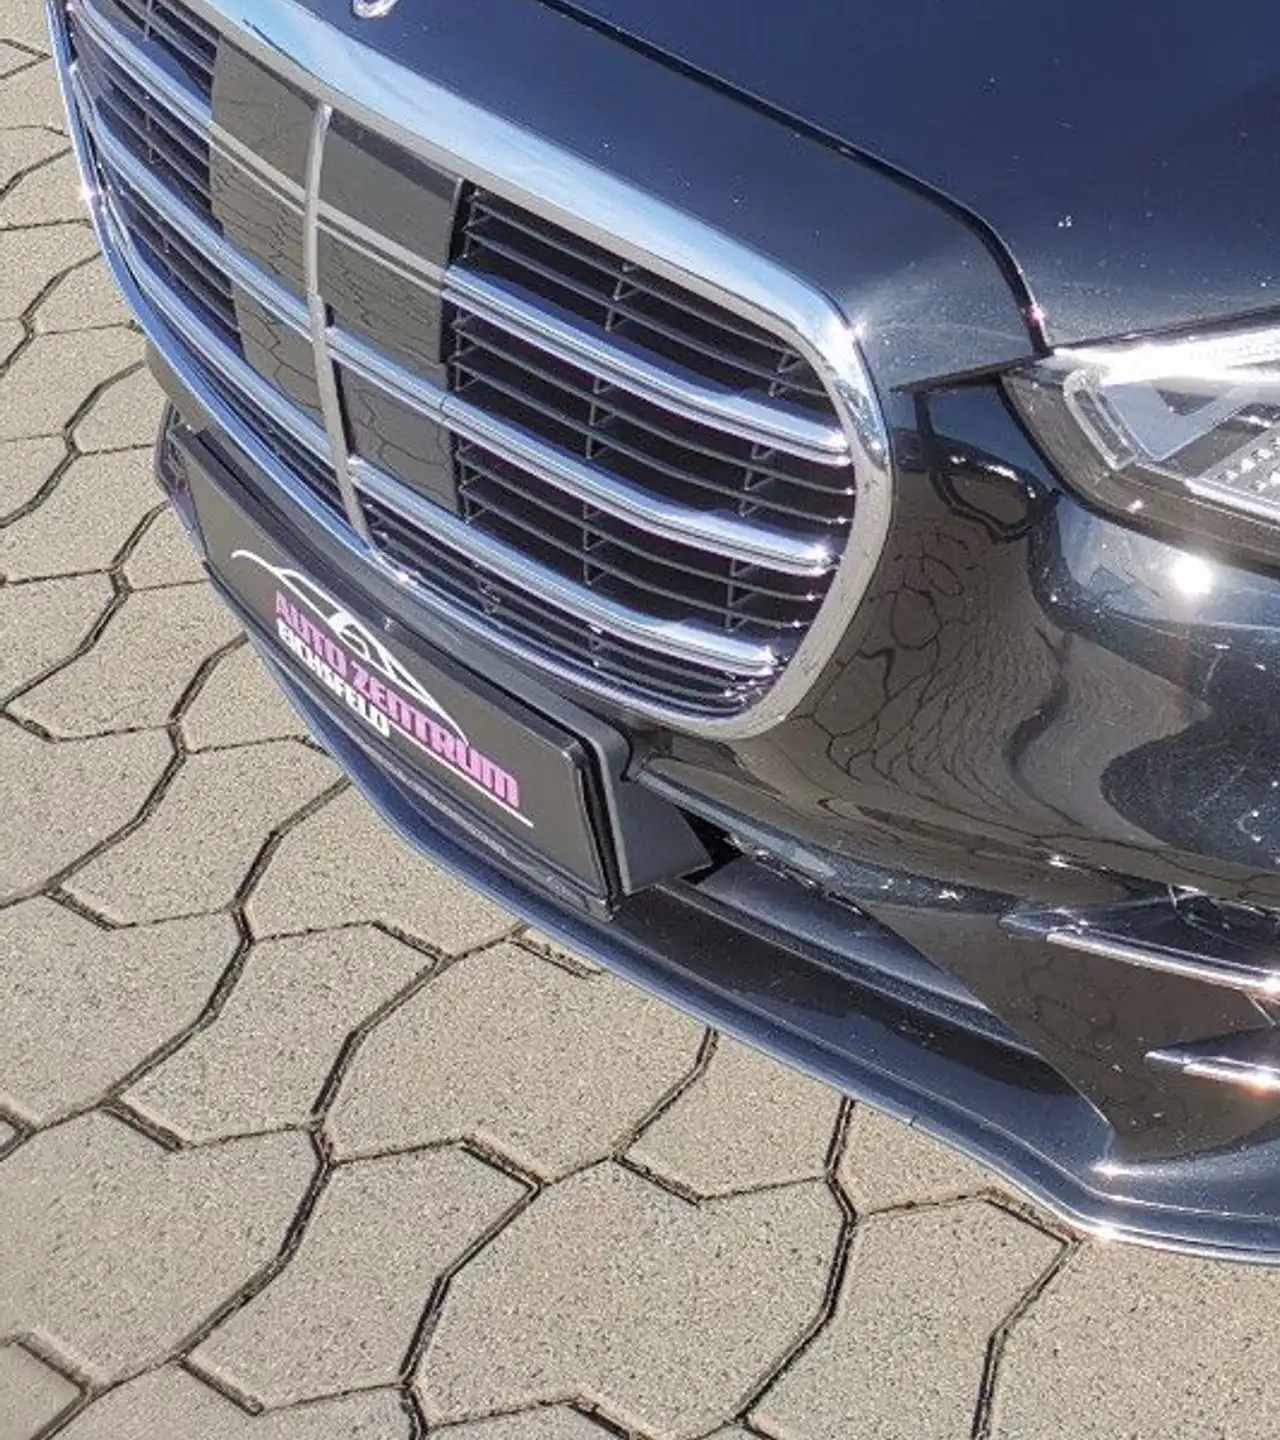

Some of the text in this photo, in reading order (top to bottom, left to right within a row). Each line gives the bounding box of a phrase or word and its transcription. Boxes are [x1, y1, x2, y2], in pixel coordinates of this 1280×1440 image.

[275, 589, 520, 809] AUTO ZENTRUM
[276, 617, 391, 738] EICHSFELD
